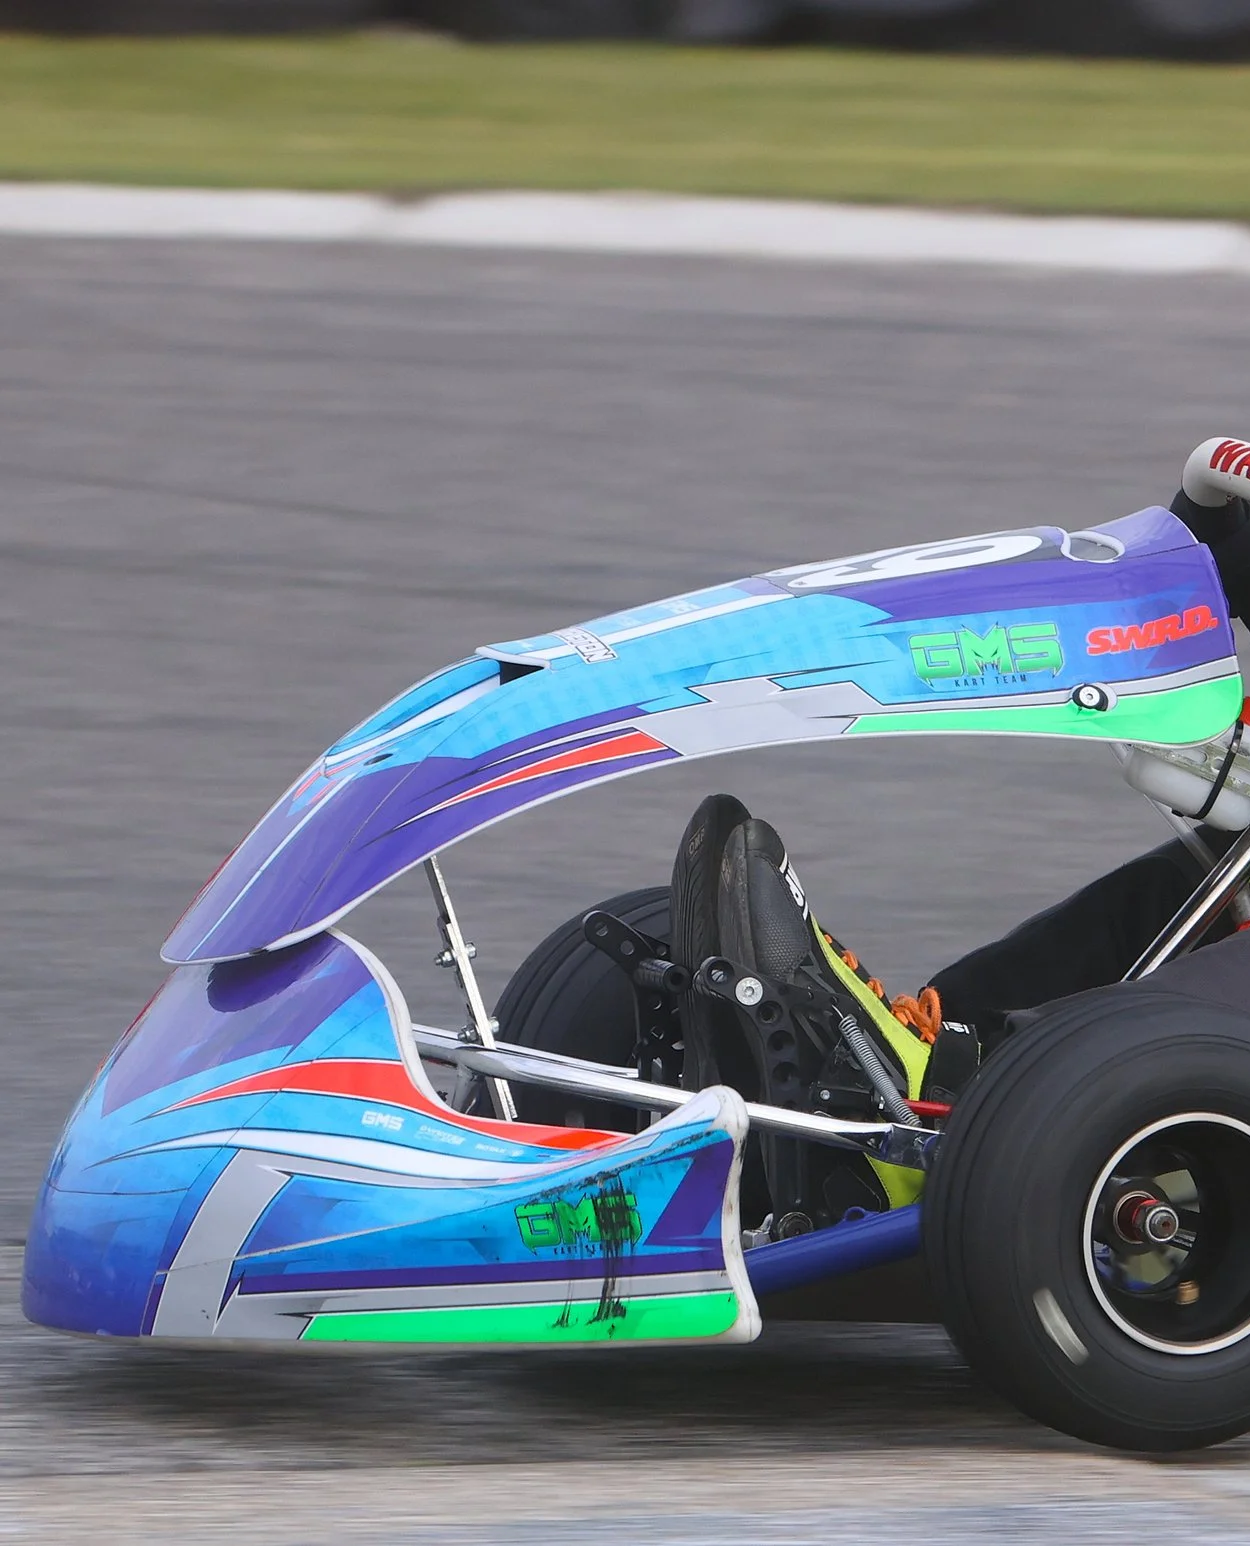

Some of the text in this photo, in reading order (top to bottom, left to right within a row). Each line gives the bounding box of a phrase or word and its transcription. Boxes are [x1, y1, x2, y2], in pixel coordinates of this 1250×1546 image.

[908, 621, 1066, 687] GMS
[954, 674, 1028, 687] KART TEAM
[361, 1110, 405, 1132] GMS
